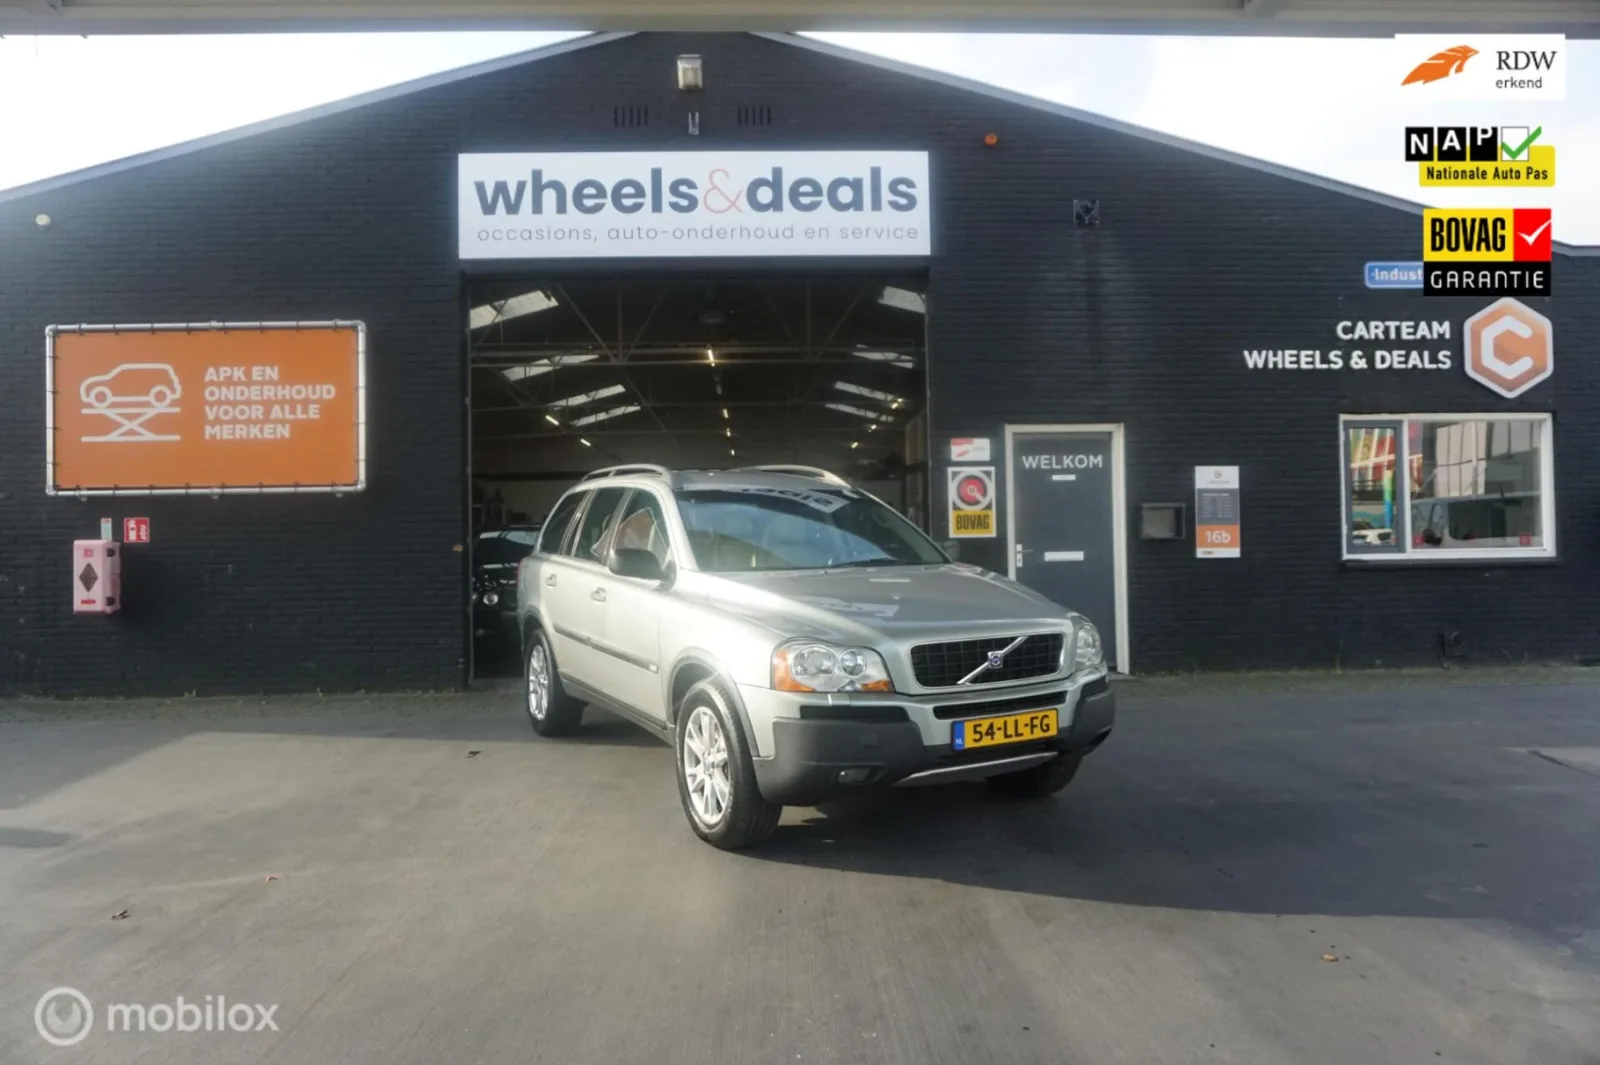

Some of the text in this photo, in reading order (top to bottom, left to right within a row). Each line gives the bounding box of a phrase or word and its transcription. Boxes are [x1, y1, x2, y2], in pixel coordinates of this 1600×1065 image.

[477, 223, 918, 243] occasions, auto-onderhoud en service
[1336, 321, 1451, 340] CARTEAM
[1243, 350, 1452, 370] WHEELS & DEALS
[204, 365, 279, 382] APK EN
[204, 384, 336, 401] ONDERHOUD
[204, 403, 321, 421] VOOR ALLE
[204, 423, 290, 440] MERKEN
[1022, 454, 1103, 470] WELKOM
[955, 513, 990, 531] BOVAG
[1205, 530, 1231, 544] 16b
[972, 715, 1050, 743] 54-LL-FG
